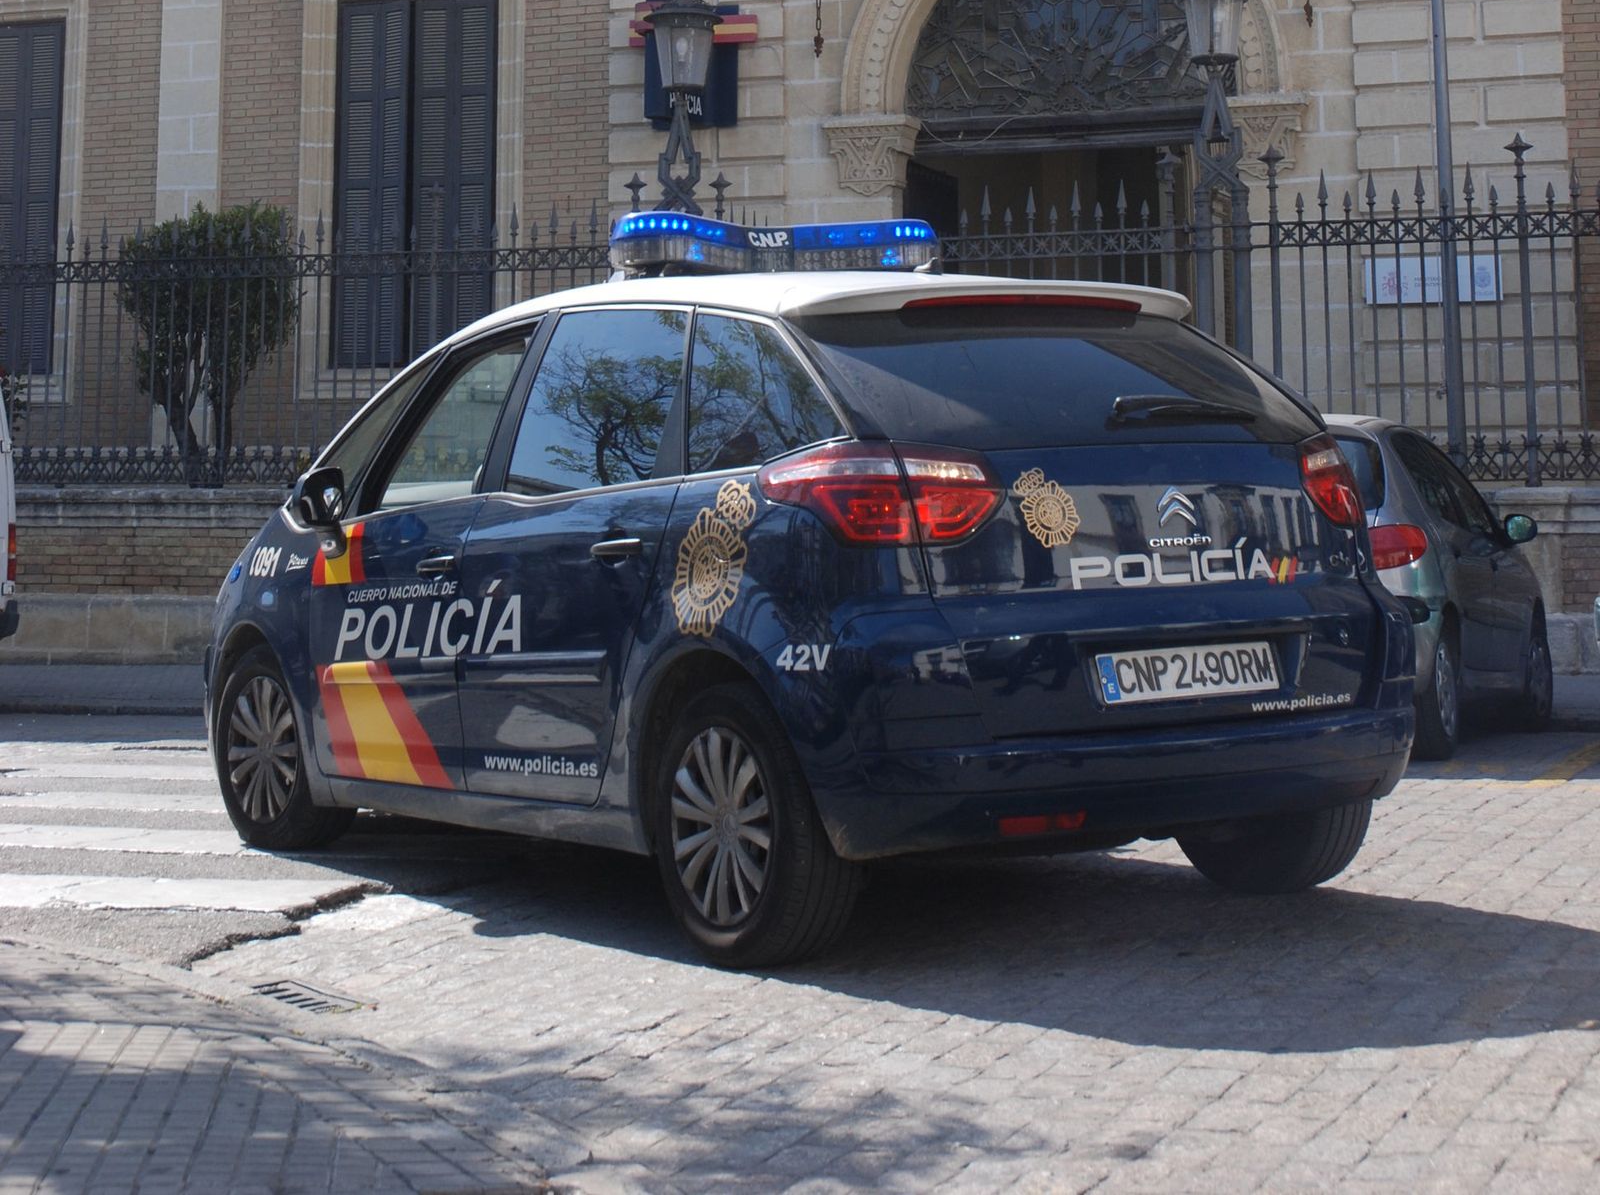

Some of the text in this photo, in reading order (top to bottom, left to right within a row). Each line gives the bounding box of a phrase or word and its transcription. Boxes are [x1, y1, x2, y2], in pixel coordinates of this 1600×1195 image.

[669, 91, 703, 116] PCIA
[249, 546, 282, 578] 1091
[1069, 536, 1275, 590] POLICÍA
[347, 580, 459, 603] CUERPO NACIONAL DE
[334, 579, 522, 661] POLICÍA
[775, 644, 831, 672] 42V
[1251, 692, 1352, 713] www.policia.es
[484, 755, 599, 777] www.policia.es
